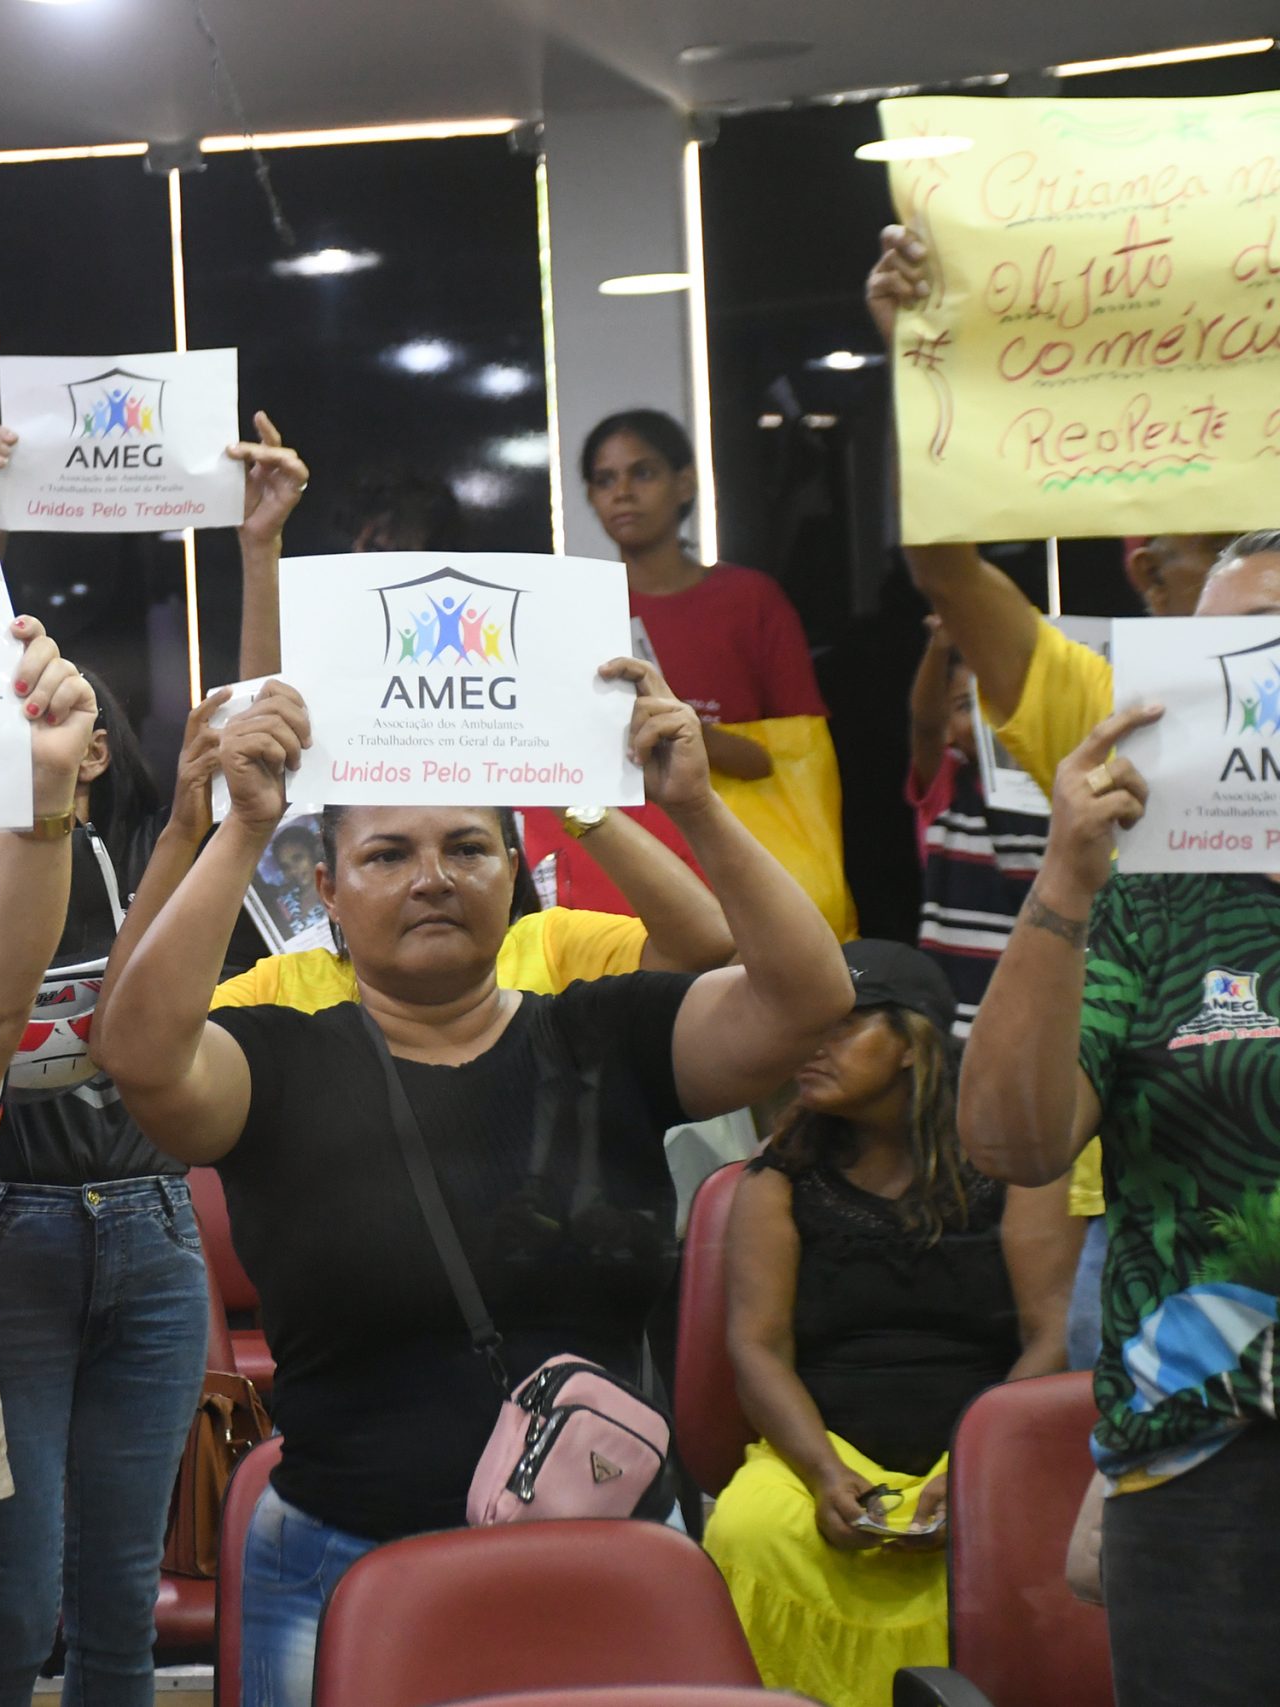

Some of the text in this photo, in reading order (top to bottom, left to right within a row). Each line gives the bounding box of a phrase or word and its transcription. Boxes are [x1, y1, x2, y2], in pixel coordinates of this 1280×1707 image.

[1231, 214, 1280, 283] d
[998, 300, 1280, 381] comérci
[64, 443, 163, 469] AMEG
[27, 499, 206, 518] Unidos Pelo Trabalho
[380, 675, 517, 710] AMEG
[373, 718, 524, 731] Associação dos Ambulantes
[347, 737, 354, 746] e
[358, 734, 435, 747] Trabalhadores
[438, 737, 455, 746] em
[459, 735, 489, 747] Geral
[493, 735, 506, 747] da
[331, 760, 584, 785] Unidos Pelo Trabalho
[1212, 790, 1277, 802] Associação
[1195, 805, 1278, 818] Trabalhadores
[1168, 829, 1253, 851] Unidos
